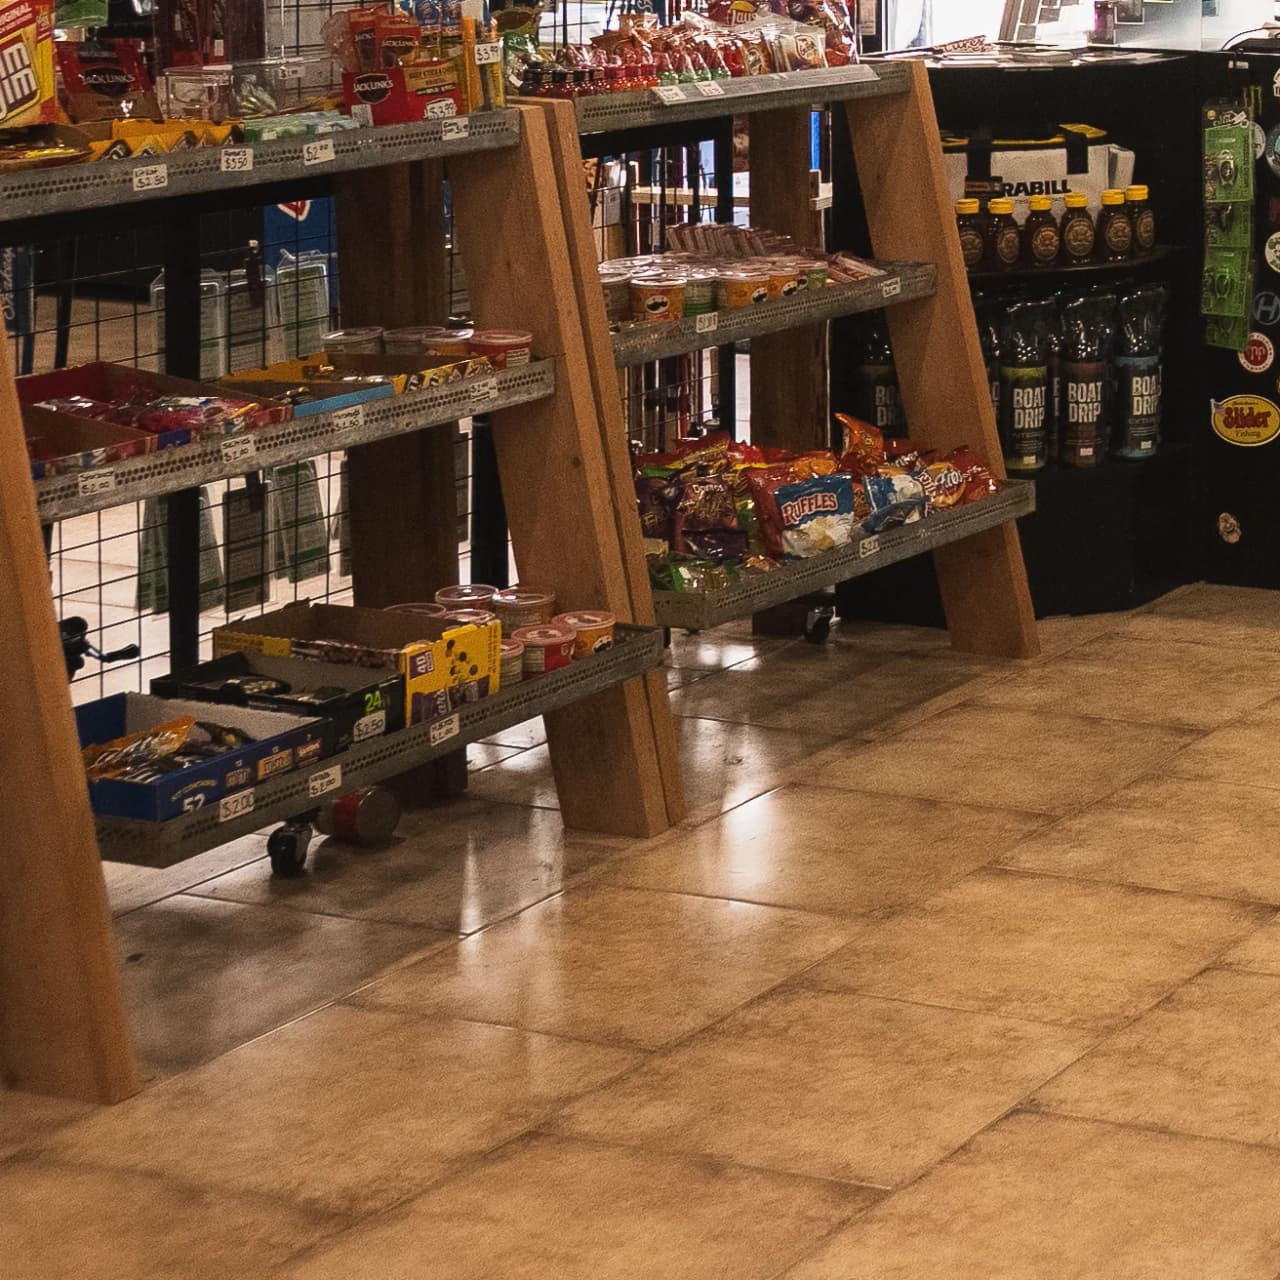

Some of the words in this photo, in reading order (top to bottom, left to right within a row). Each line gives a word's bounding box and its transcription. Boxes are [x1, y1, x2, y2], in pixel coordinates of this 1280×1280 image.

[1000, 178, 1072, 197] RABILL
[1013, 387, 1047, 409] BOAT
[1068, 381, 1103, 403] BOAT
[1013, 408, 1045, 430] DRIP
[1068, 402, 1102, 424] DRIP
[1223, 406, 1273, 429] Slider
[780, 490, 839, 526] RUFFLES
